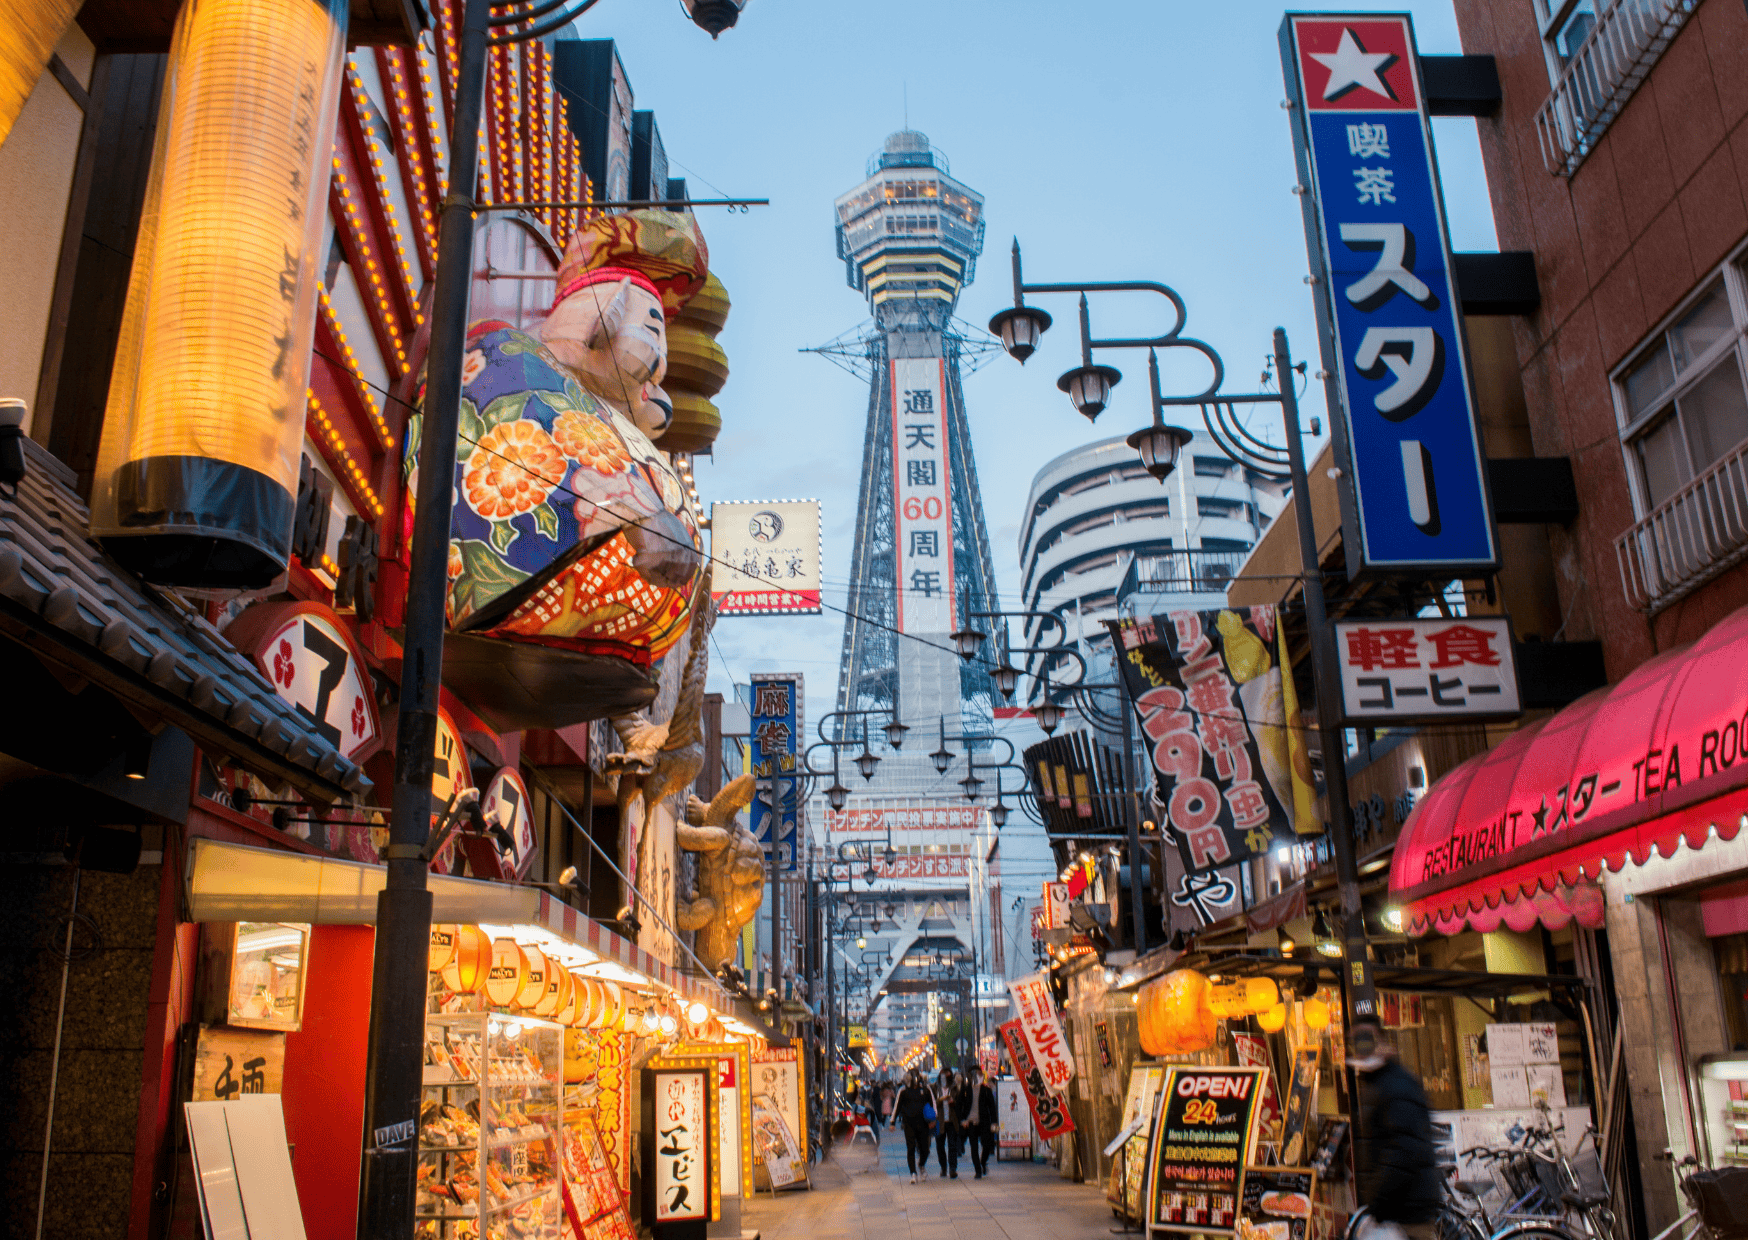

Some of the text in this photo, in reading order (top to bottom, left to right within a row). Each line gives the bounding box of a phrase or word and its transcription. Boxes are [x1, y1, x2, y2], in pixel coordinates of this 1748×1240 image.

[1346, 122, 1396, 206] 喫茶
[1338, 222, 1436, 530] スター
[903, 389, 942, 599] 通天閣60周年
[1345, 624, 1502, 671] 軽食
[752, 682, 792, 756] 麻雀
[1356, 673, 1502, 709] コーヒー
[1134, 685, 1232, 870] 290円
[1422, 809, 1522, 883] RESTAURANT
[1551, 771, 1622, 833] スター
[1631, 743, 1683, 804] TEA
[1177, 1075, 1253, 1100] OPEN!
[1182, 1098, 1217, 1125] 24
[376, 1120, 415, 1147] DAVE
